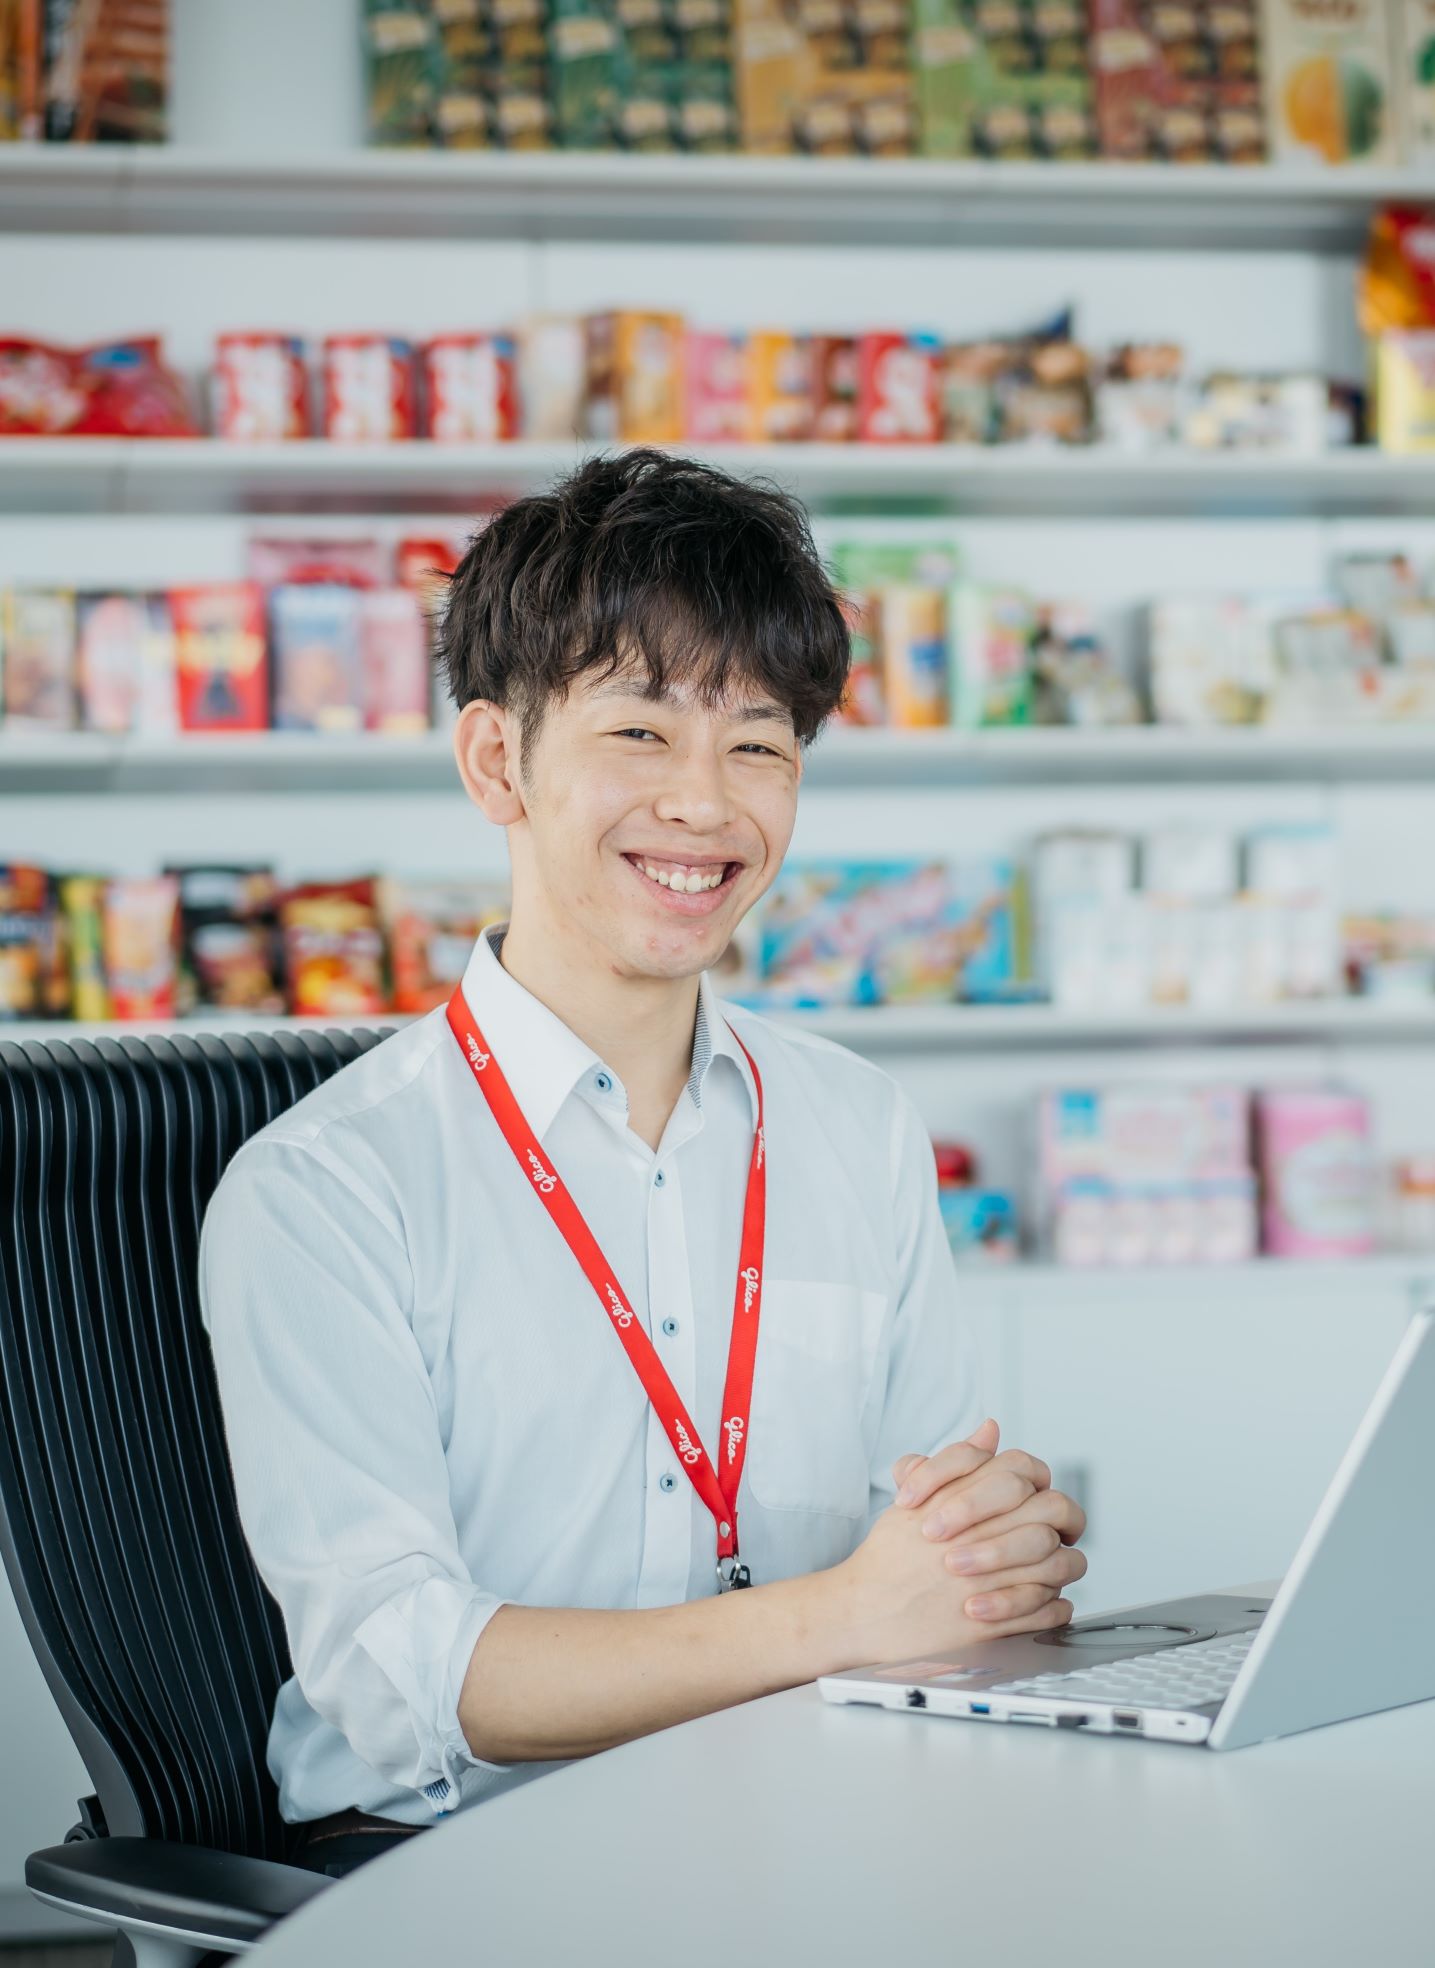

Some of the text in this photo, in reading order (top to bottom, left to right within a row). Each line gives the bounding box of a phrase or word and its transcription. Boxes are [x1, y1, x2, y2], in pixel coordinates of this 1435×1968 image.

[526, 1148, 558, 1193] Glico
[605, 1282, 633, 1328] Glico
[741, 1267, 759, 1313] Glico
[675, 1418, 702, 1464] Glico
[723, 1416, 745, 1465] Glico
